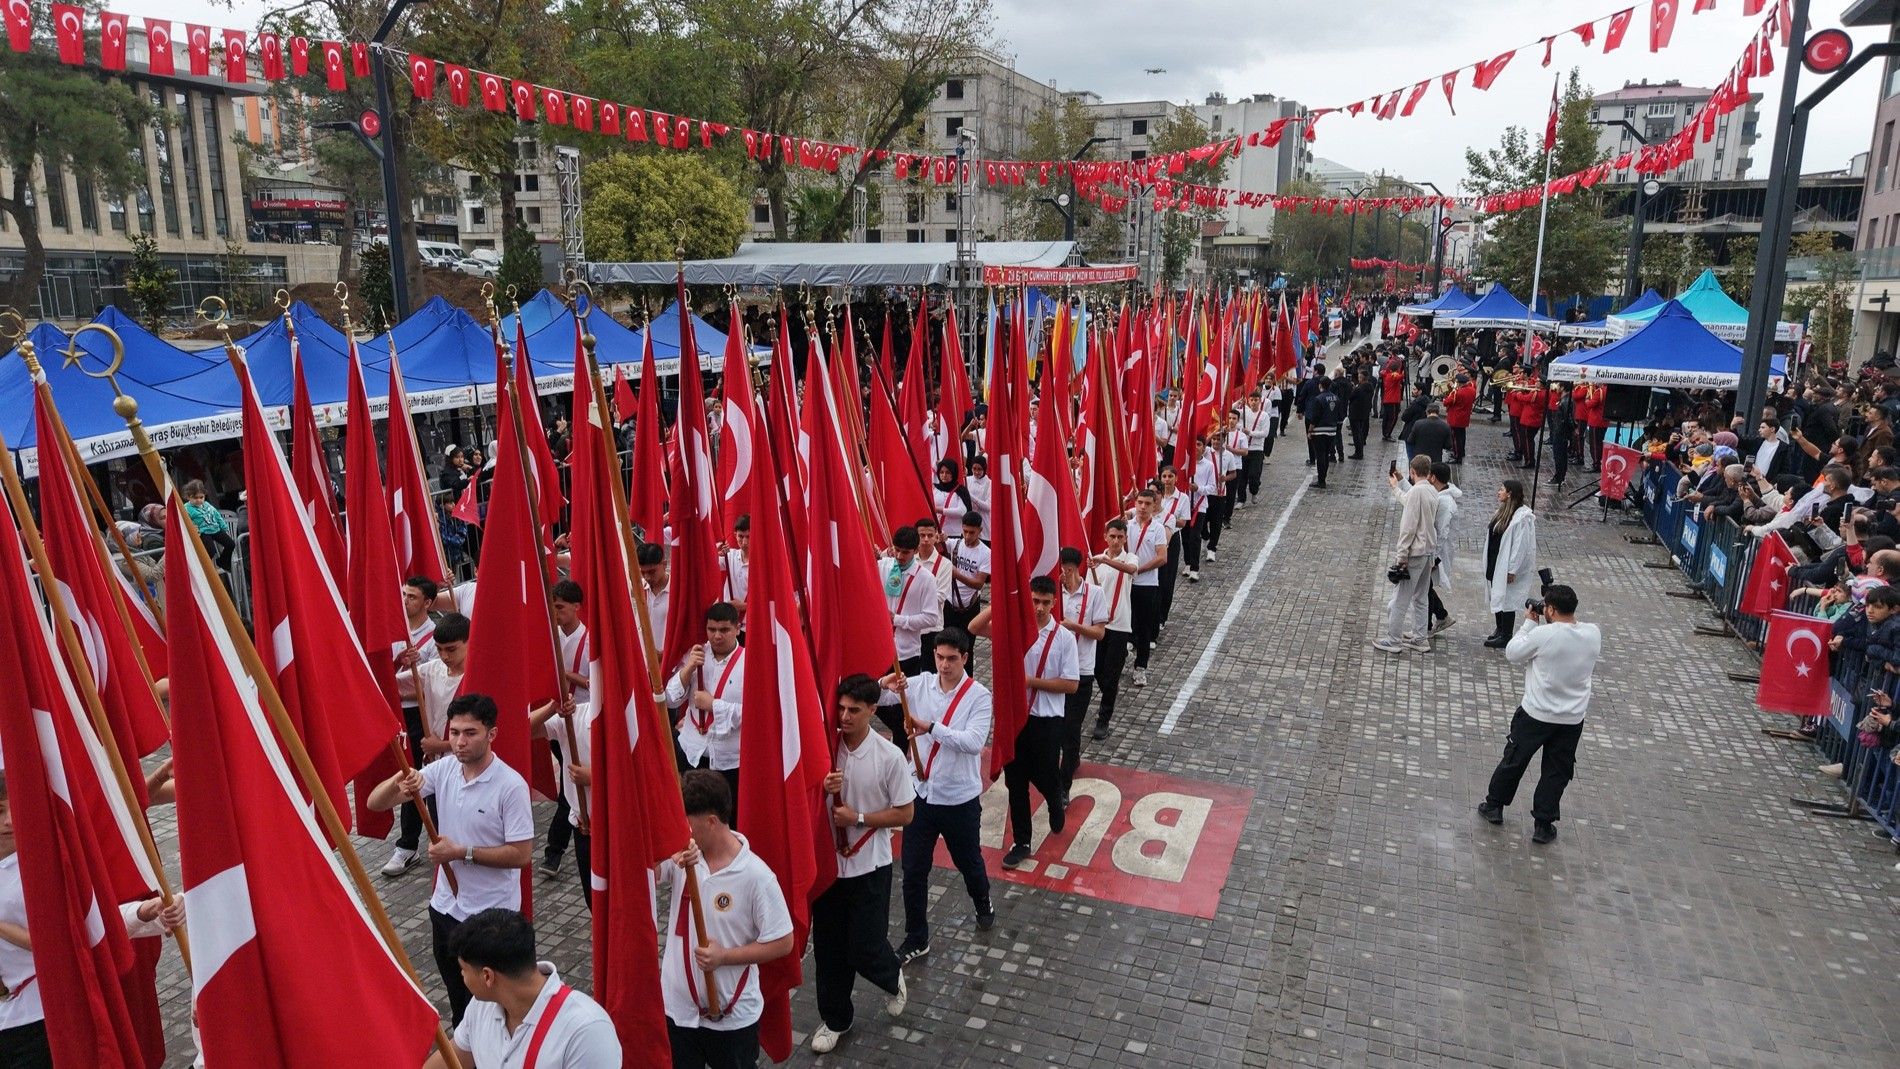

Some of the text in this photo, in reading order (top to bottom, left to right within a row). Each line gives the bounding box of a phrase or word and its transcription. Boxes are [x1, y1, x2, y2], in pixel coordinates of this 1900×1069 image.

[1595, 369, 1658, 384] Kahramanmaraş
[1659, 371, 1696, 386] Büyükşehir
[1698, 374, 1733, 387] Belediyesi
[90, 430, 169, 456] Kahramaaraş
[170, 420, 209, 441] Büyükşehir
[211, 417, 243, 434] Belediyes
